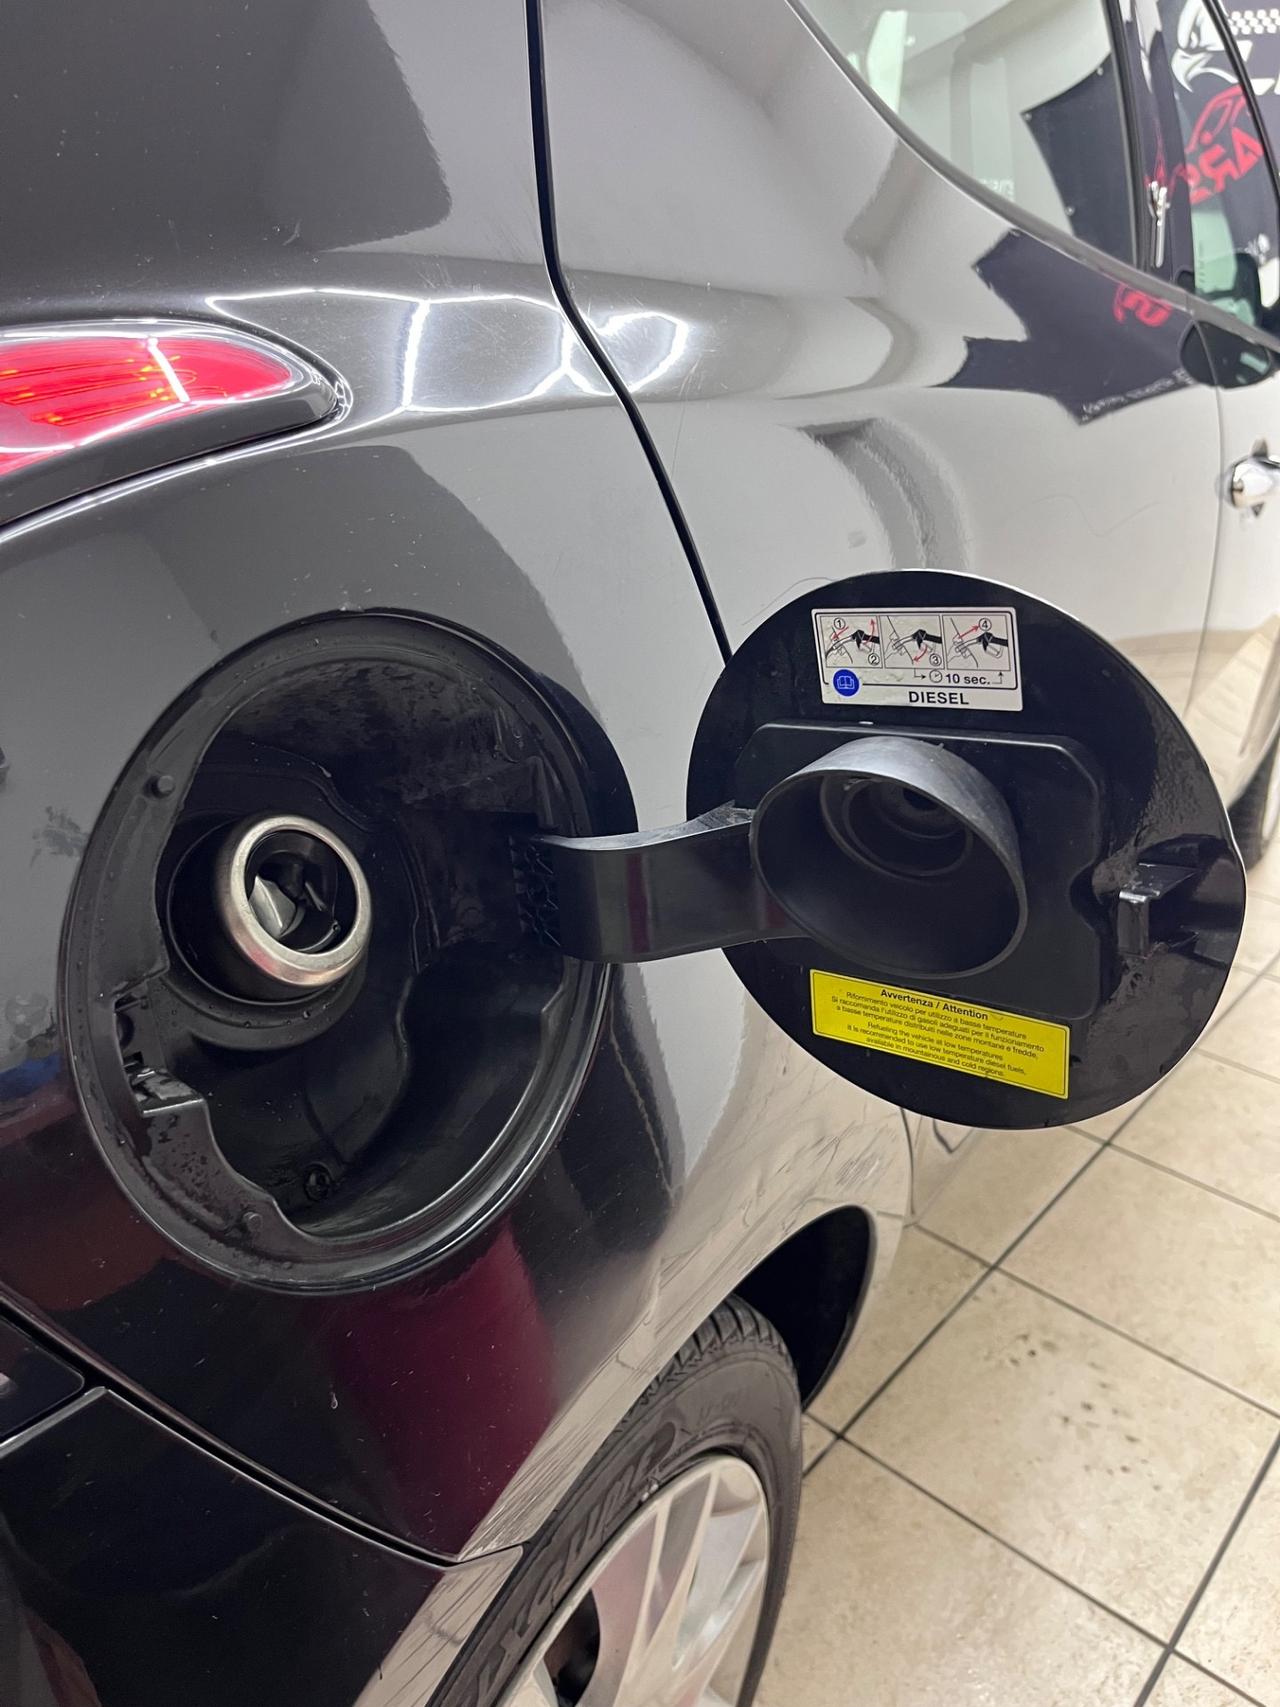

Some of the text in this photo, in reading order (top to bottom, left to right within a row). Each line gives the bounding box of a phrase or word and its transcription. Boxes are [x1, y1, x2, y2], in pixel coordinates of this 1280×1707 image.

[946, 673, 990, 685] 10 sec.
[908, 691, 970, 705] DIESEL
[881, 989, 933, 1007] Avvertenza
[943, 1003, 988, 1021] Attention
[863, 1011, 903, 1026] temperature
[955, 1034, 971, 1042] zone
[974, 1038, 1004, 1050] montane
[928, 1011, 952, 1022] utilizzo
[960, 1018, 981, 1028] basse
[983, 1024, 1027, 1040] temperature
[859, 1027, 906, 1044] recommended
[929, 1045, 941, 1053] low
[943, 1048, 984, 1064] temperature
[985, 1059, 1005, 1069] diesel
[911, 1033, 934, 1043] vehicle
[944, 1041, 956, 1049] low
[958, 1044, 1003, 1062] temperatures
[971, 1029, 983, 1038] per
[991, 1033, 1045, 1053] funzionamento
[903, 1046, 946, 1061] mountainous
[962, 1061, 977, 1069] cold
